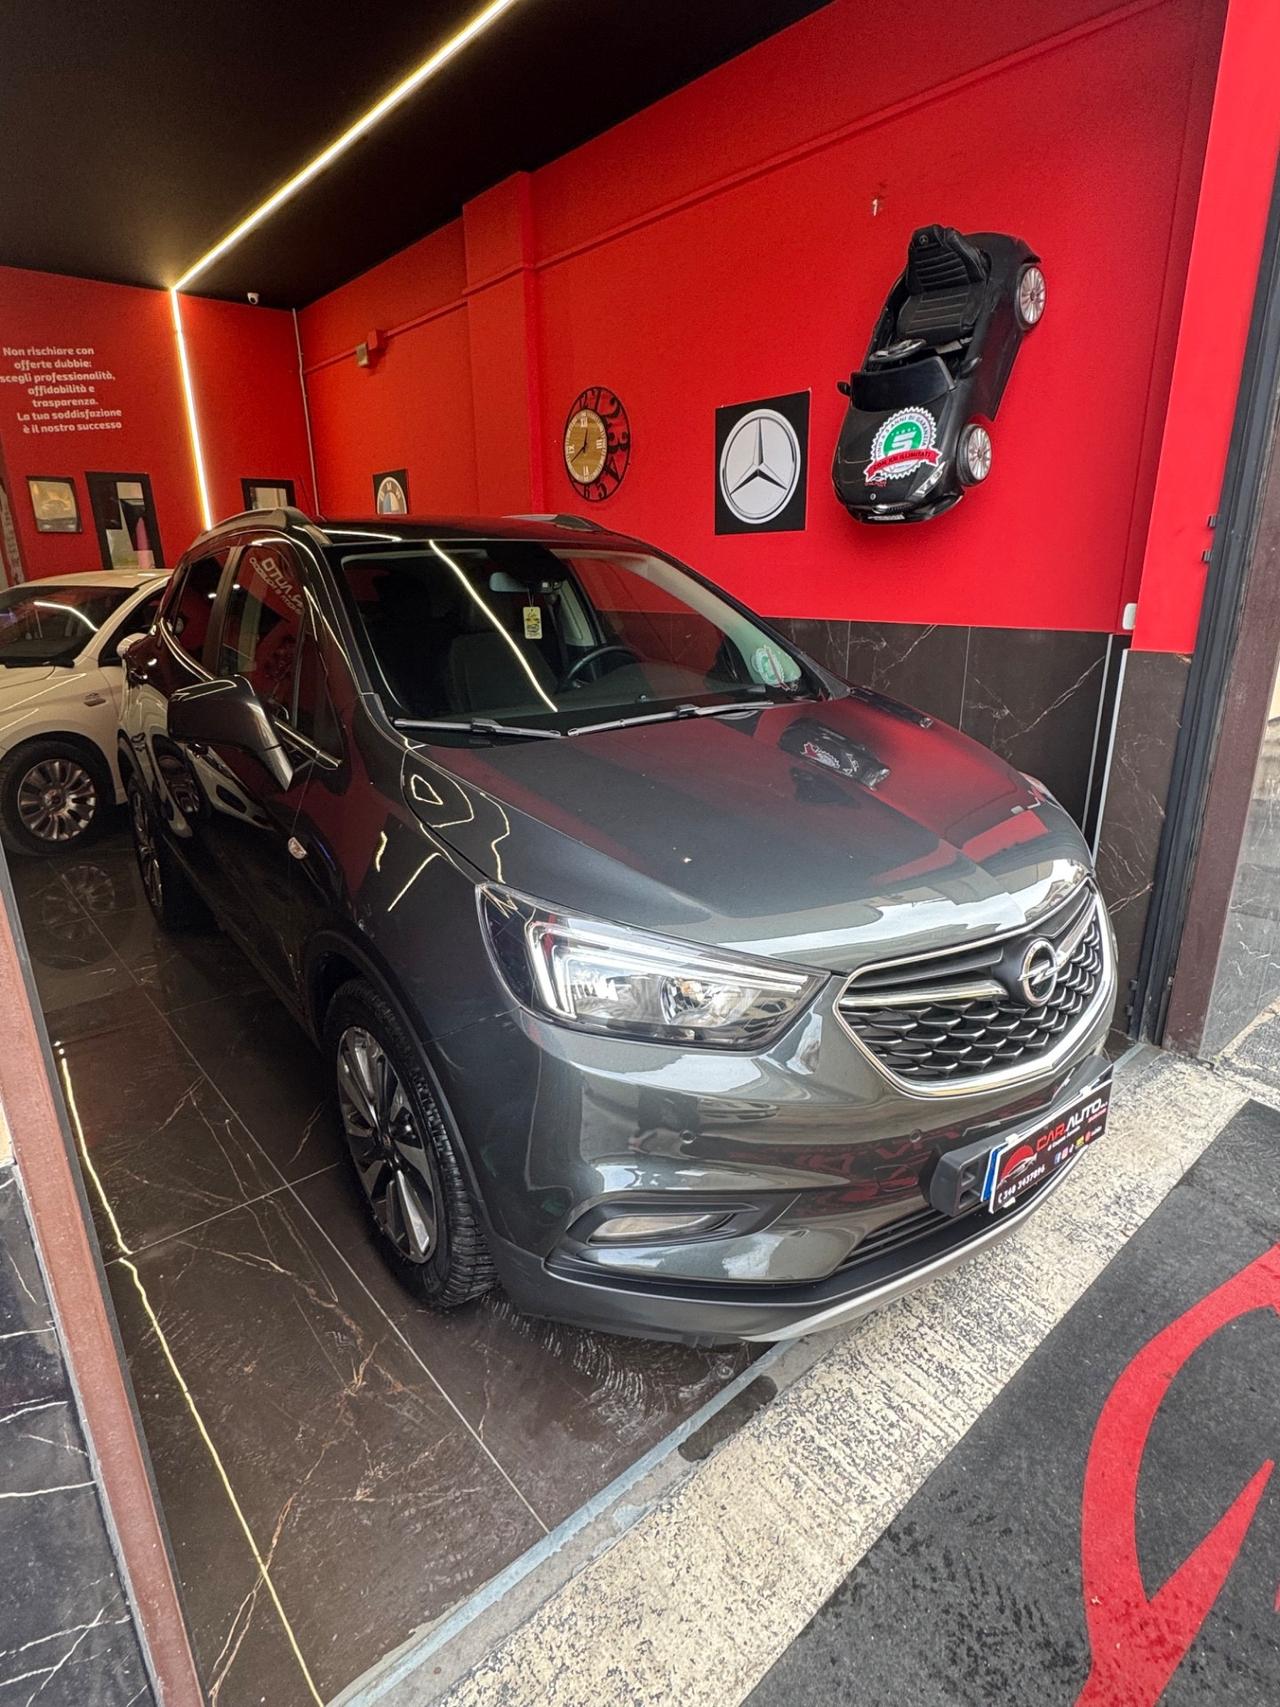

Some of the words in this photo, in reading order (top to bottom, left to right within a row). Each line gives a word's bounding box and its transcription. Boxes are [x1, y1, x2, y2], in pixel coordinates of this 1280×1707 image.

[3, 347, 25, 356] Non
[27, 346, 74, 356] rischiare
[76, 347, 95, 355] con
[14, 360, 52, 371] offerte
[54, 358, 92, 369] dubbie:
[0, 373, 32, 384] scegli
[28, 384, 87, 396] affidabilità
[88, 385, 95, 393] e
[17, 412, 30, 421] La
[32, 412, 50, 421] tua
[51, 408, 122, 420] soddisfazione
[23, 425, 30, 434] è
[31, 424, 40, 433] il
[41, 423, 76, 433] nostro
[77, 421, 122, 431] successo
